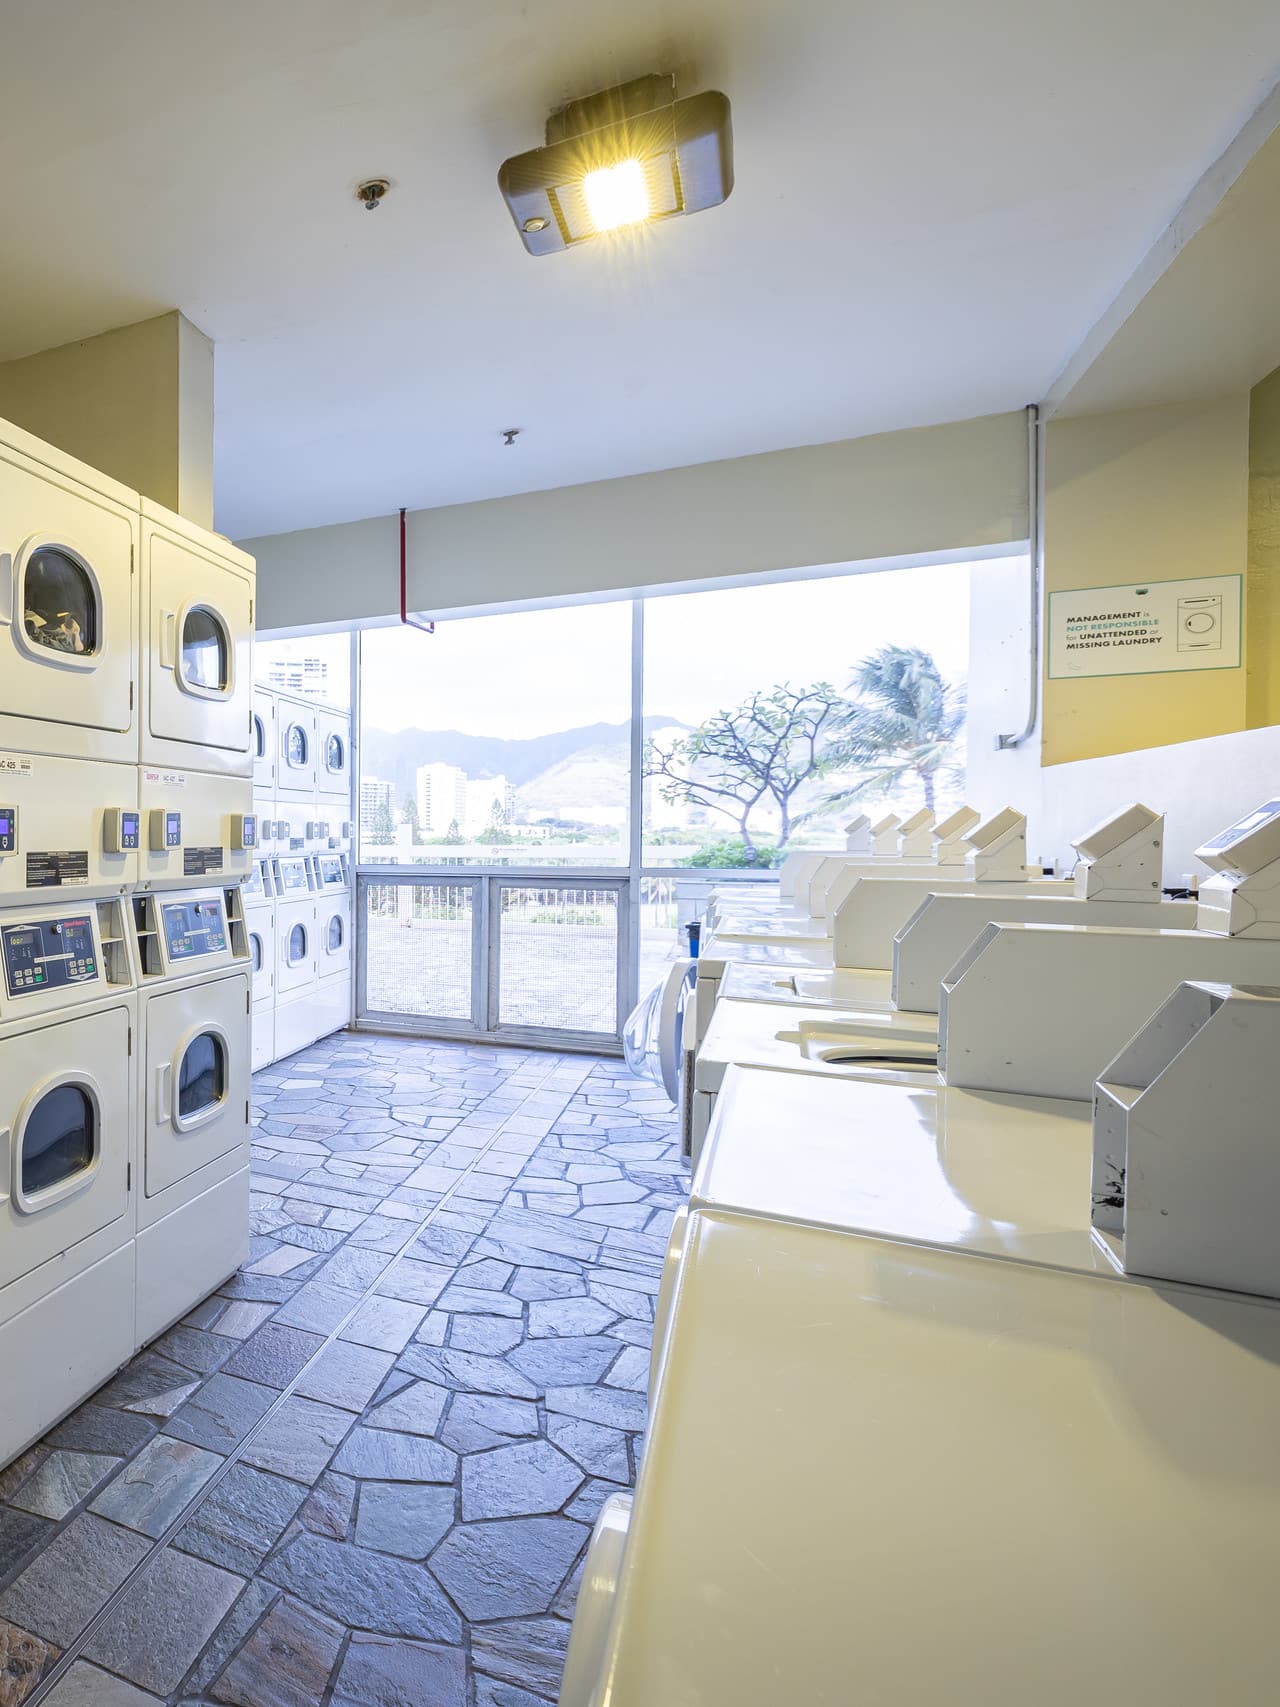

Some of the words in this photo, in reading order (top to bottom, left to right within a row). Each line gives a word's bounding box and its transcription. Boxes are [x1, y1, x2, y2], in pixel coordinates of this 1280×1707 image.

[1067, 612, 1141, 623] MANAGEMENT
[1091, 619, 1159, 629] RESPONSIBLE
[1080, 629, 1147, 639] UNATTENDED
[1066, 641, 1110, 649] MISSING
[1113, 637, 1162, 646] LAUNDRY
